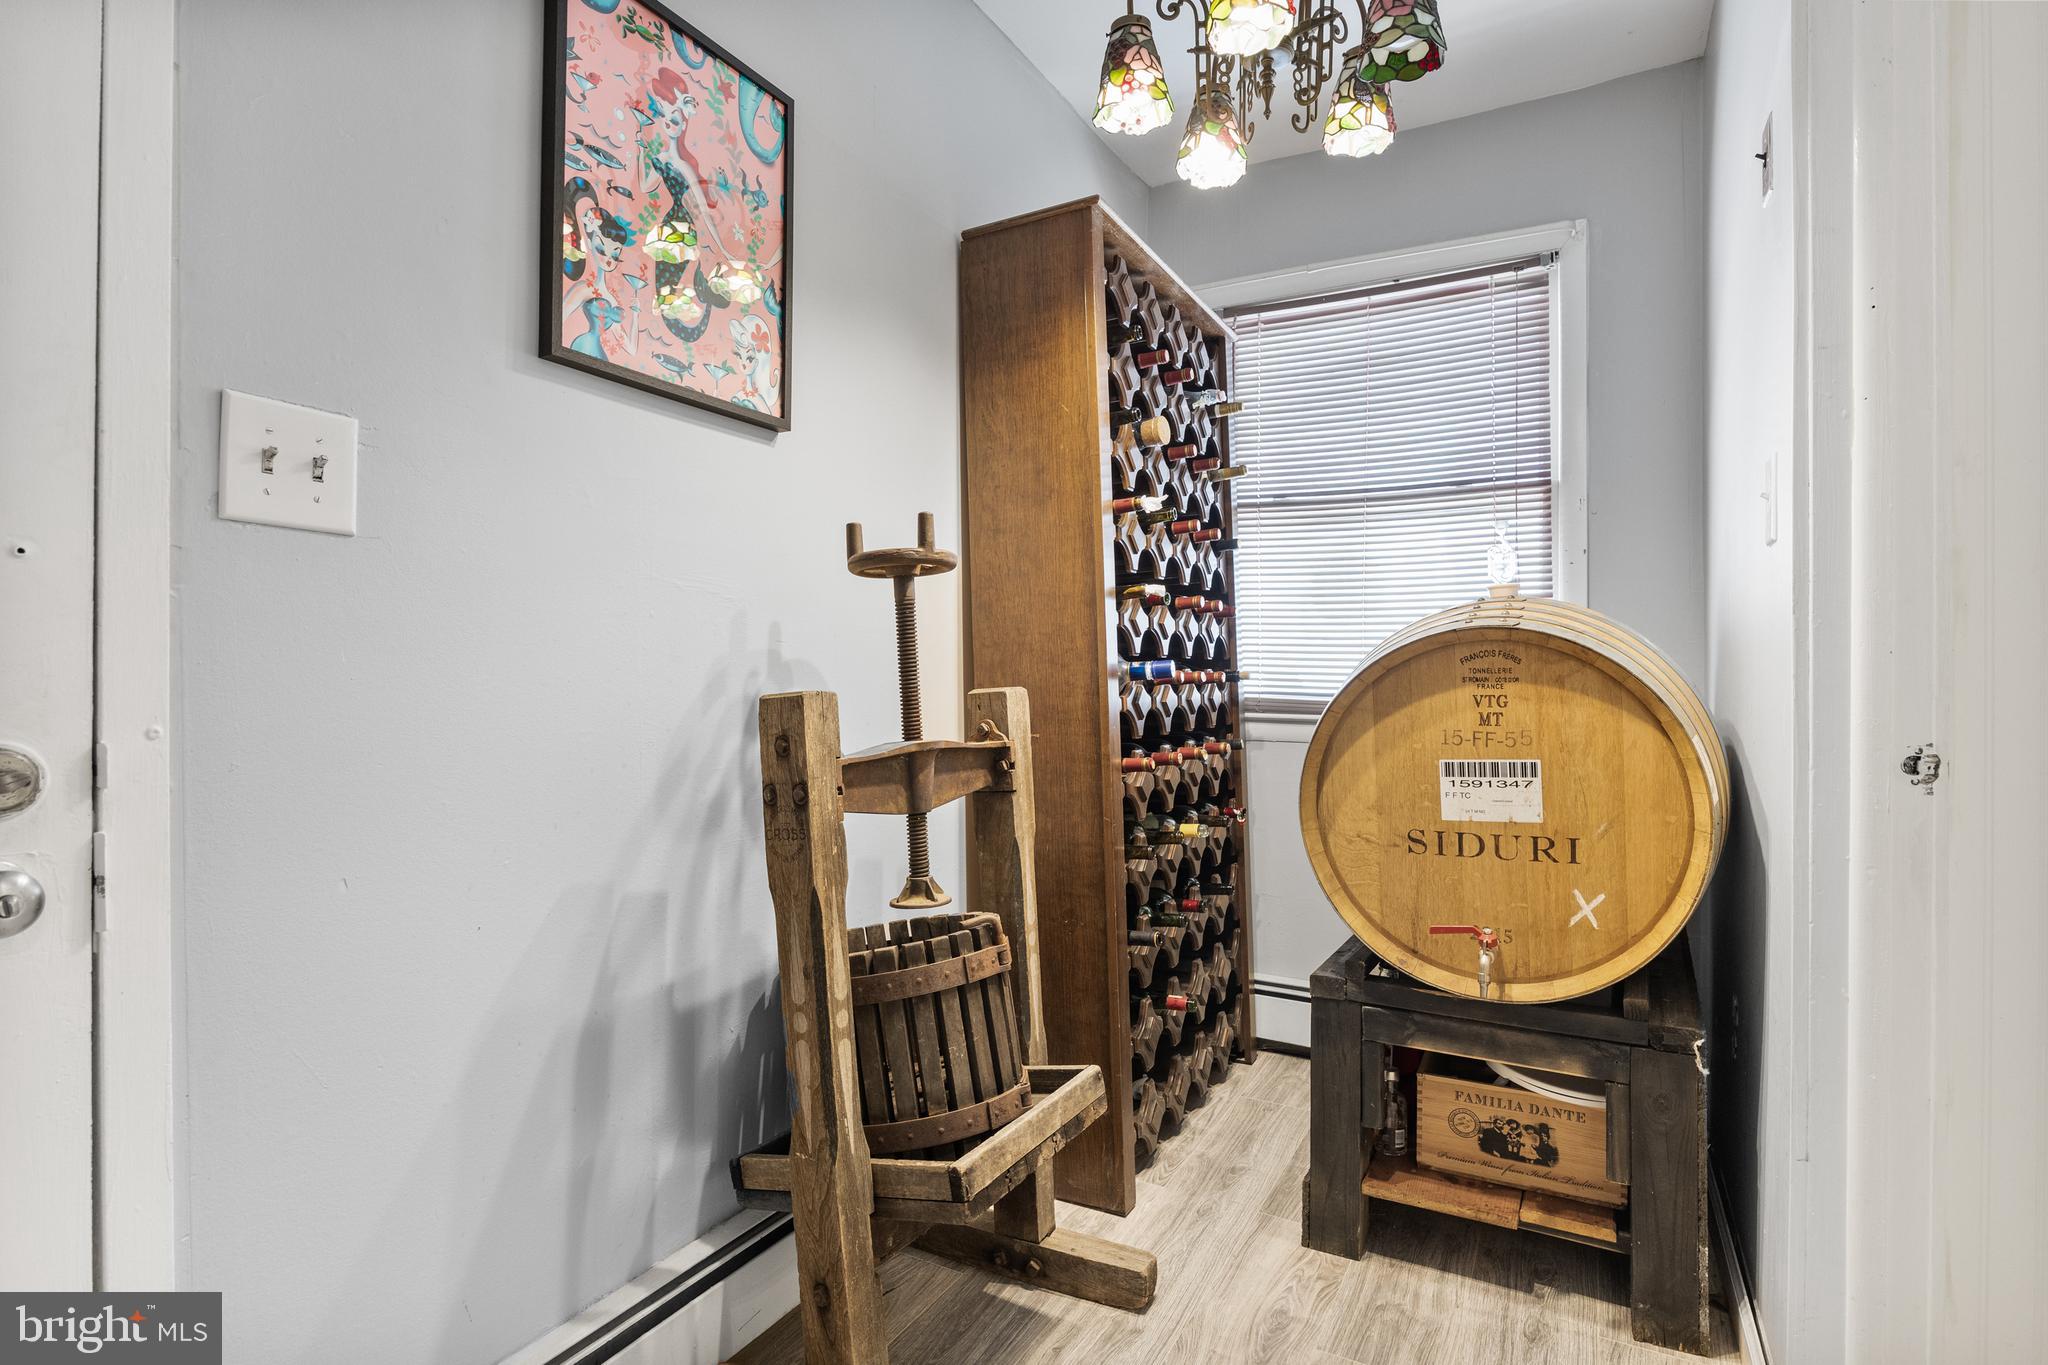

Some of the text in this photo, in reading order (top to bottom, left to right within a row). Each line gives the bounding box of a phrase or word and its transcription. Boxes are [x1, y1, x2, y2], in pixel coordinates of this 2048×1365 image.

[1472, 694, 1509, 709] VTG
[1478, 711, 1504, 727] MT
[1440, 729, 1534, 748] 15-FF-55
[1448, 779, 1534, 789] 1591347
[1407, 828, 1582, 865] SIDURI
[1454, 1090, 1587, 1124] FAMILIA DANTE
